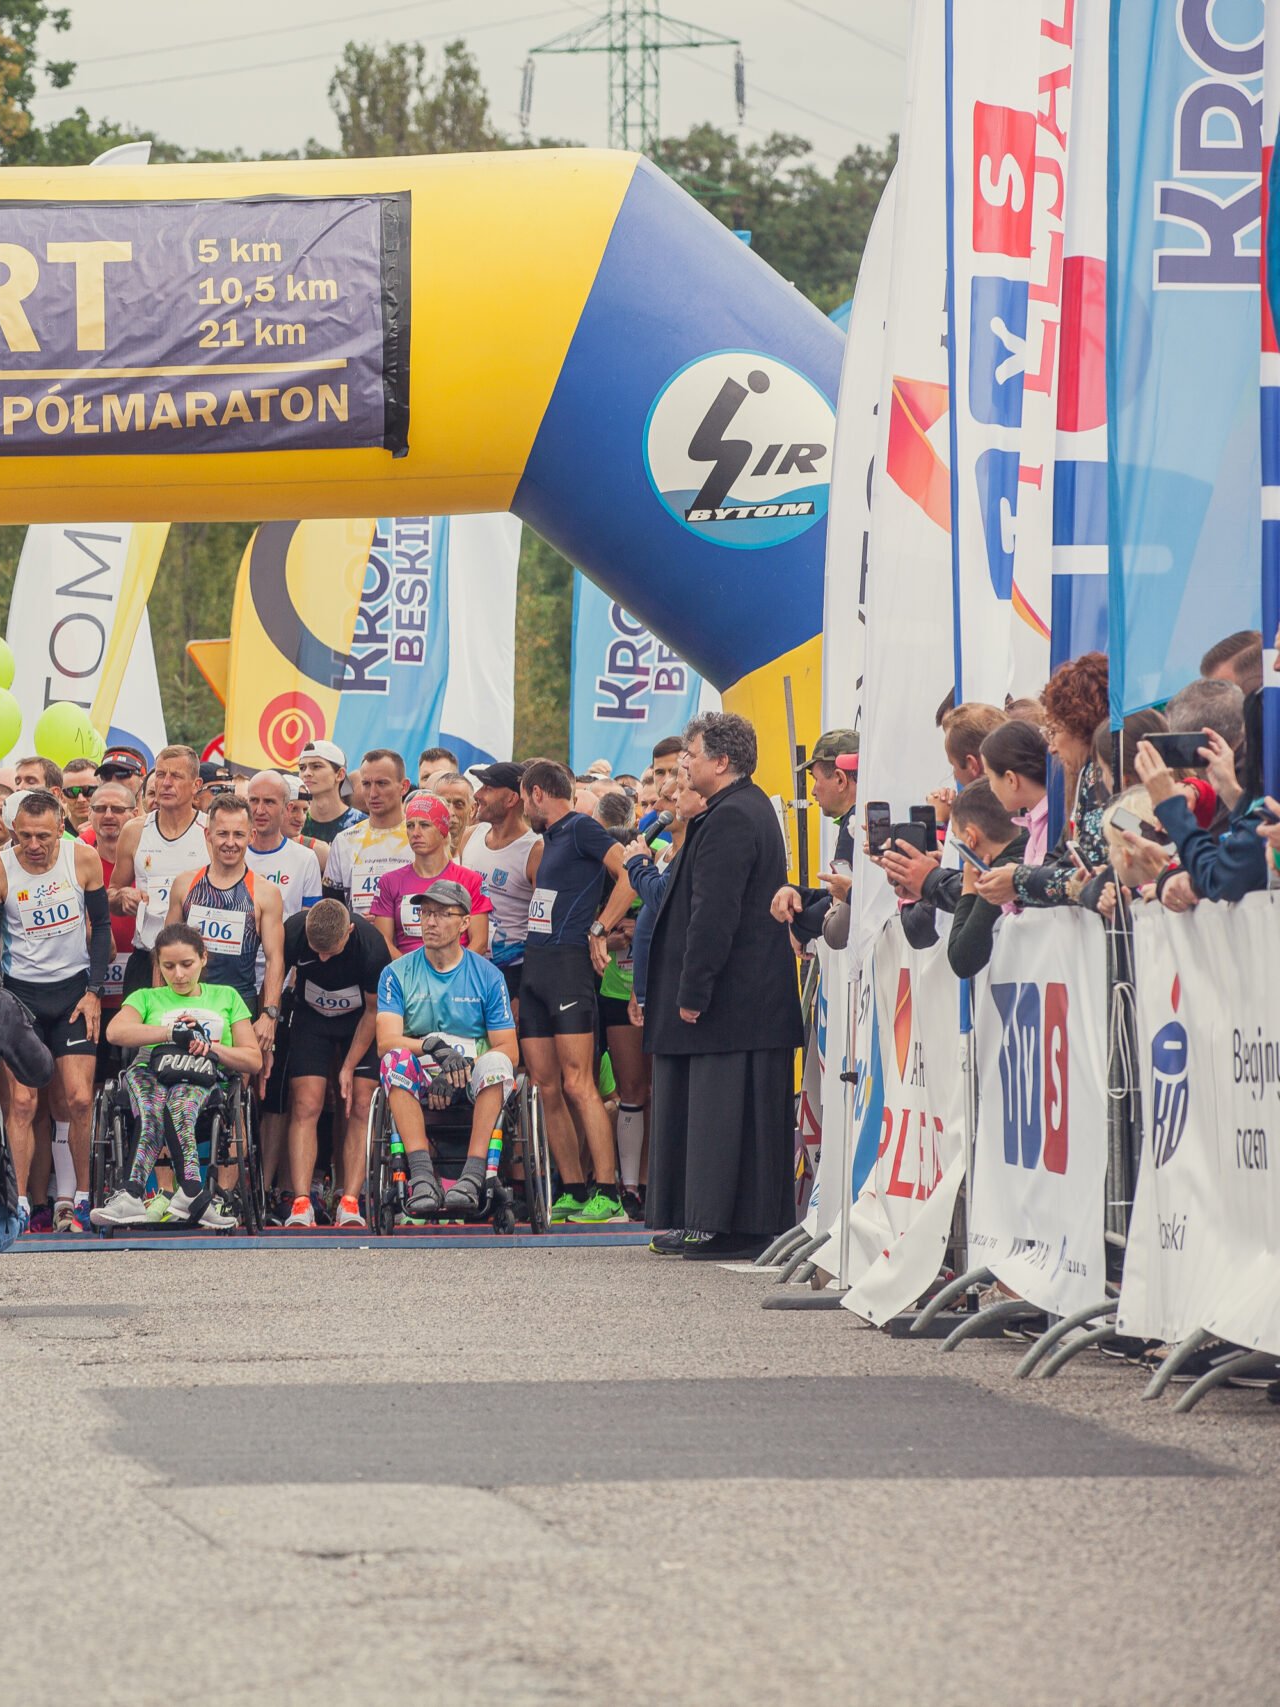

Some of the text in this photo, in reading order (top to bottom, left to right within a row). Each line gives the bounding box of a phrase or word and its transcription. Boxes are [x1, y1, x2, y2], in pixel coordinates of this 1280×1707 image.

[197, 237, 282, 263] 5 km
[197, 272, 338, 306] 10,5 km
[198, 317, 306, 348] 21 km
[3, 382, 350, 436] PÓŁMARATON
[687, 503, 812, 522] BYTOM
[32, 903, 70, 926] 810
[199, 919, 233, 940] 106
[315, 997, 351, 1009] 490
[157, 1054, 215, 1075] PUMA
[999, 1015, 1064, 1140] TVS
